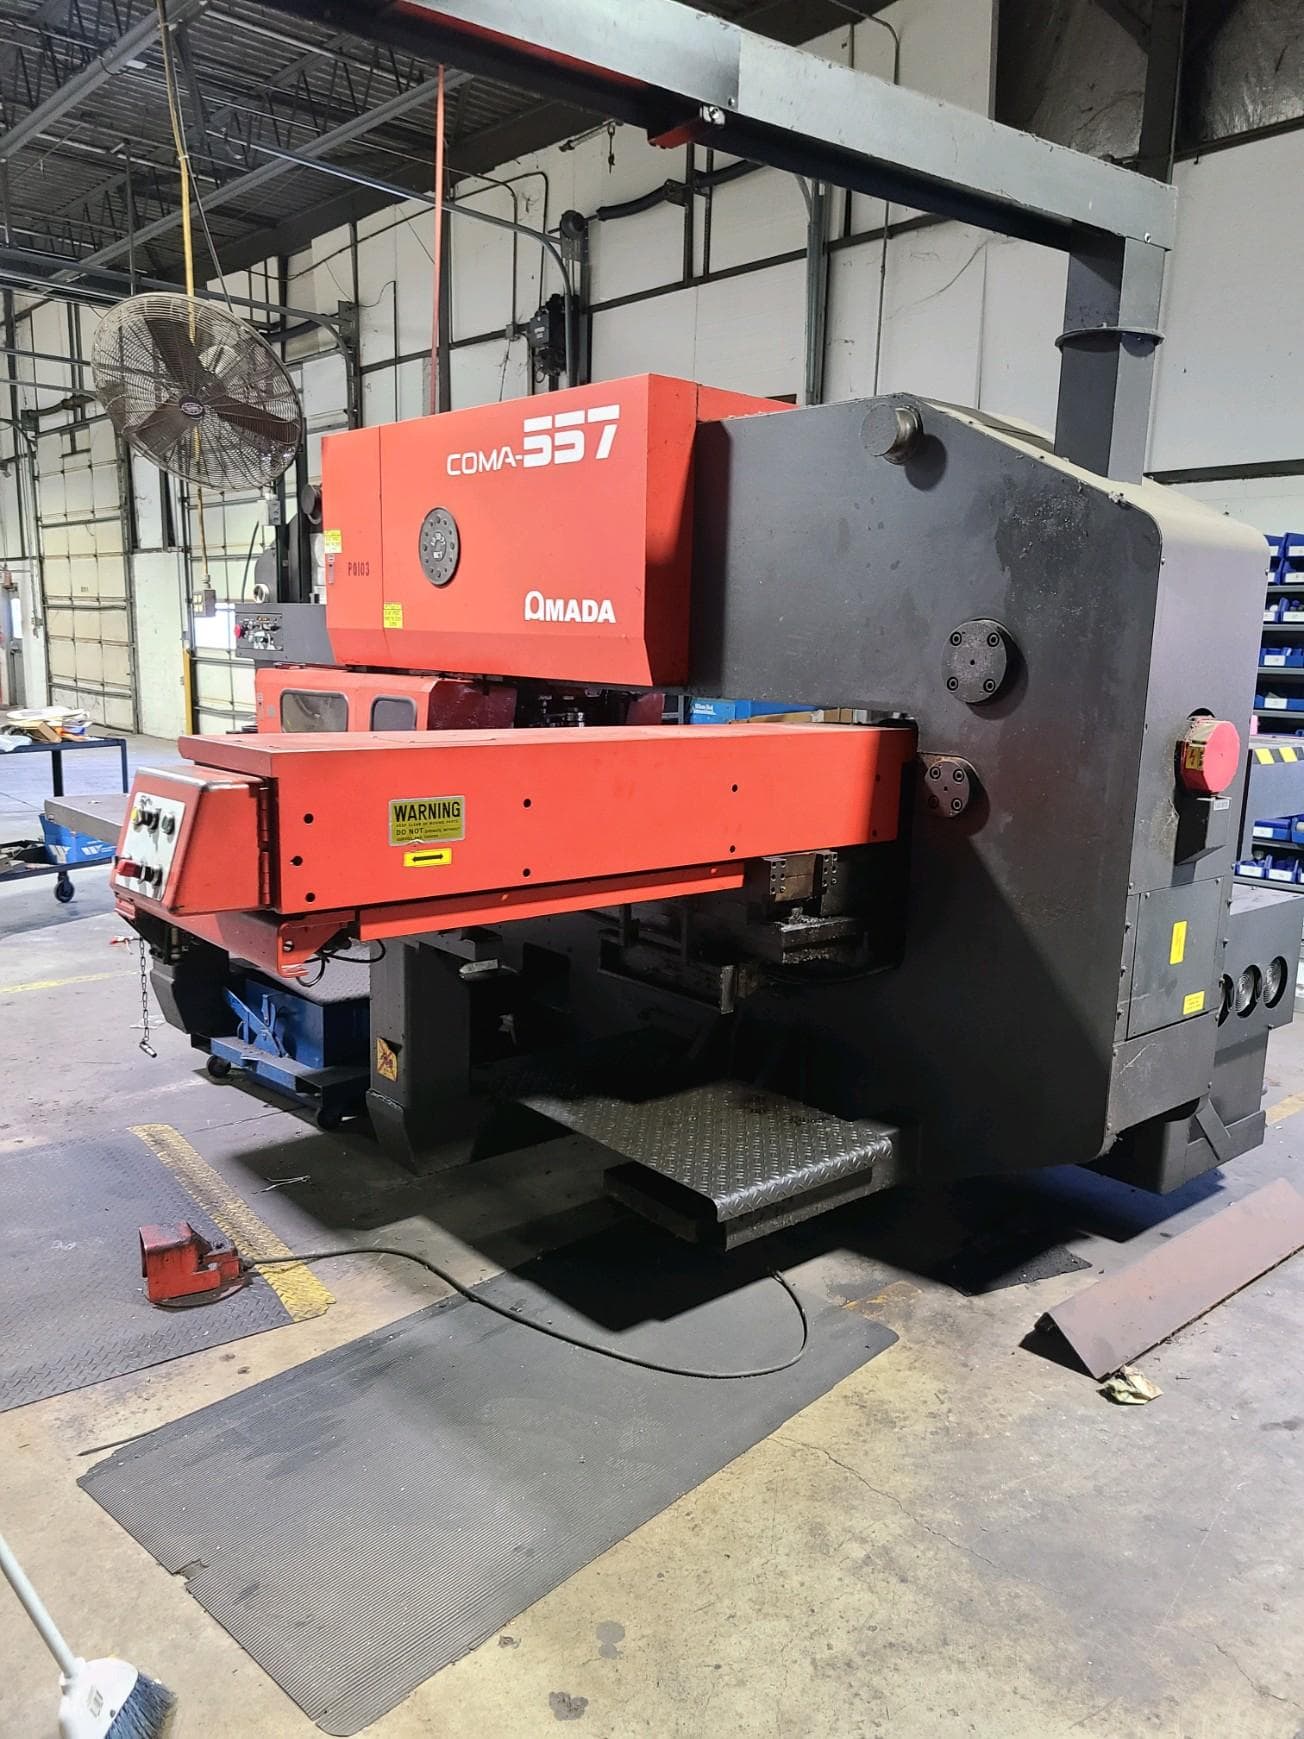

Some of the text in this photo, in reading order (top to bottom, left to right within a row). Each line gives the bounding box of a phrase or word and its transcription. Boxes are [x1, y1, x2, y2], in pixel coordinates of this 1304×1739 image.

[446, 404, 620, 476] COMA-557
[524, 590, 617, 624] AMADA
[394, 801, 460, 822] WARNING
[408, 827, 425, 835] NOT
